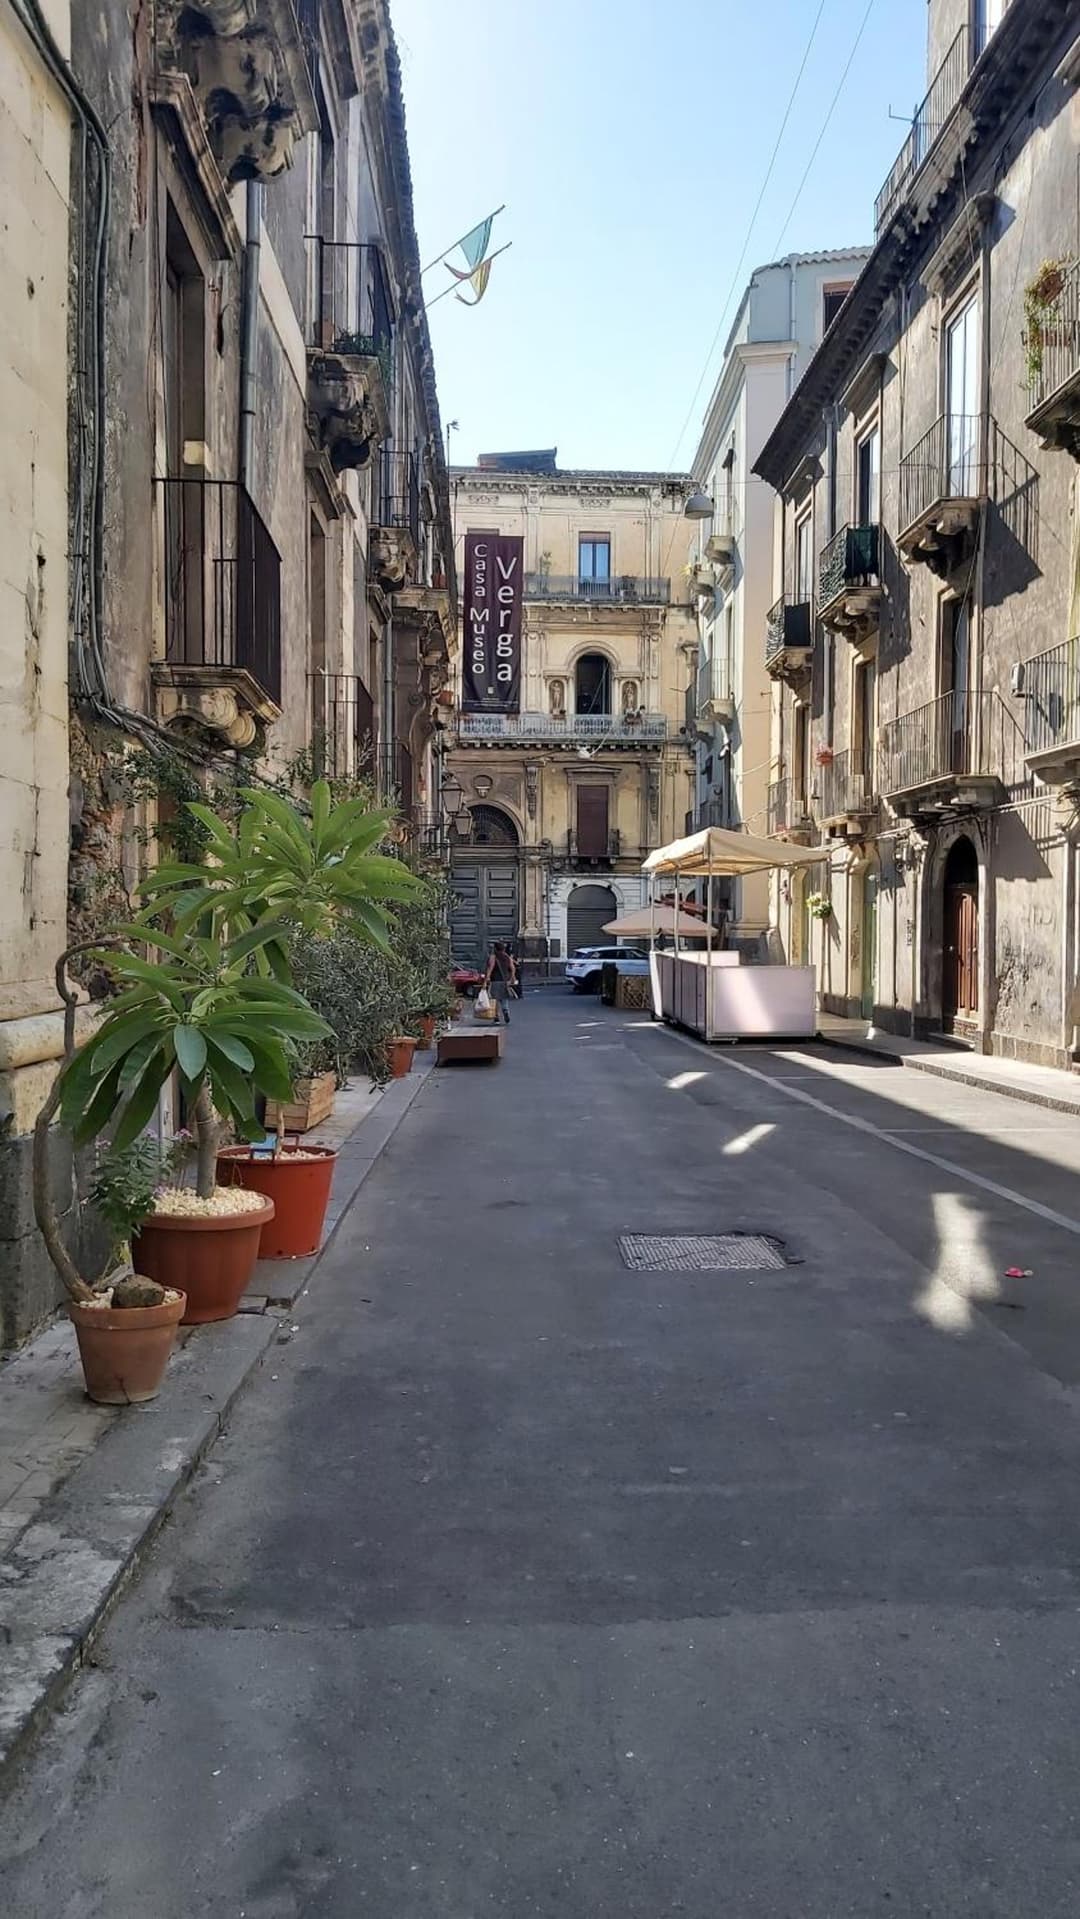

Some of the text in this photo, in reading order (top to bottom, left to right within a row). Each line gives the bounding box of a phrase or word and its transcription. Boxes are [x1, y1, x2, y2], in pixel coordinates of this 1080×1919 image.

[470, 544, 489, 674] Casa Museo
[496, 556, 517, 682] Verga
